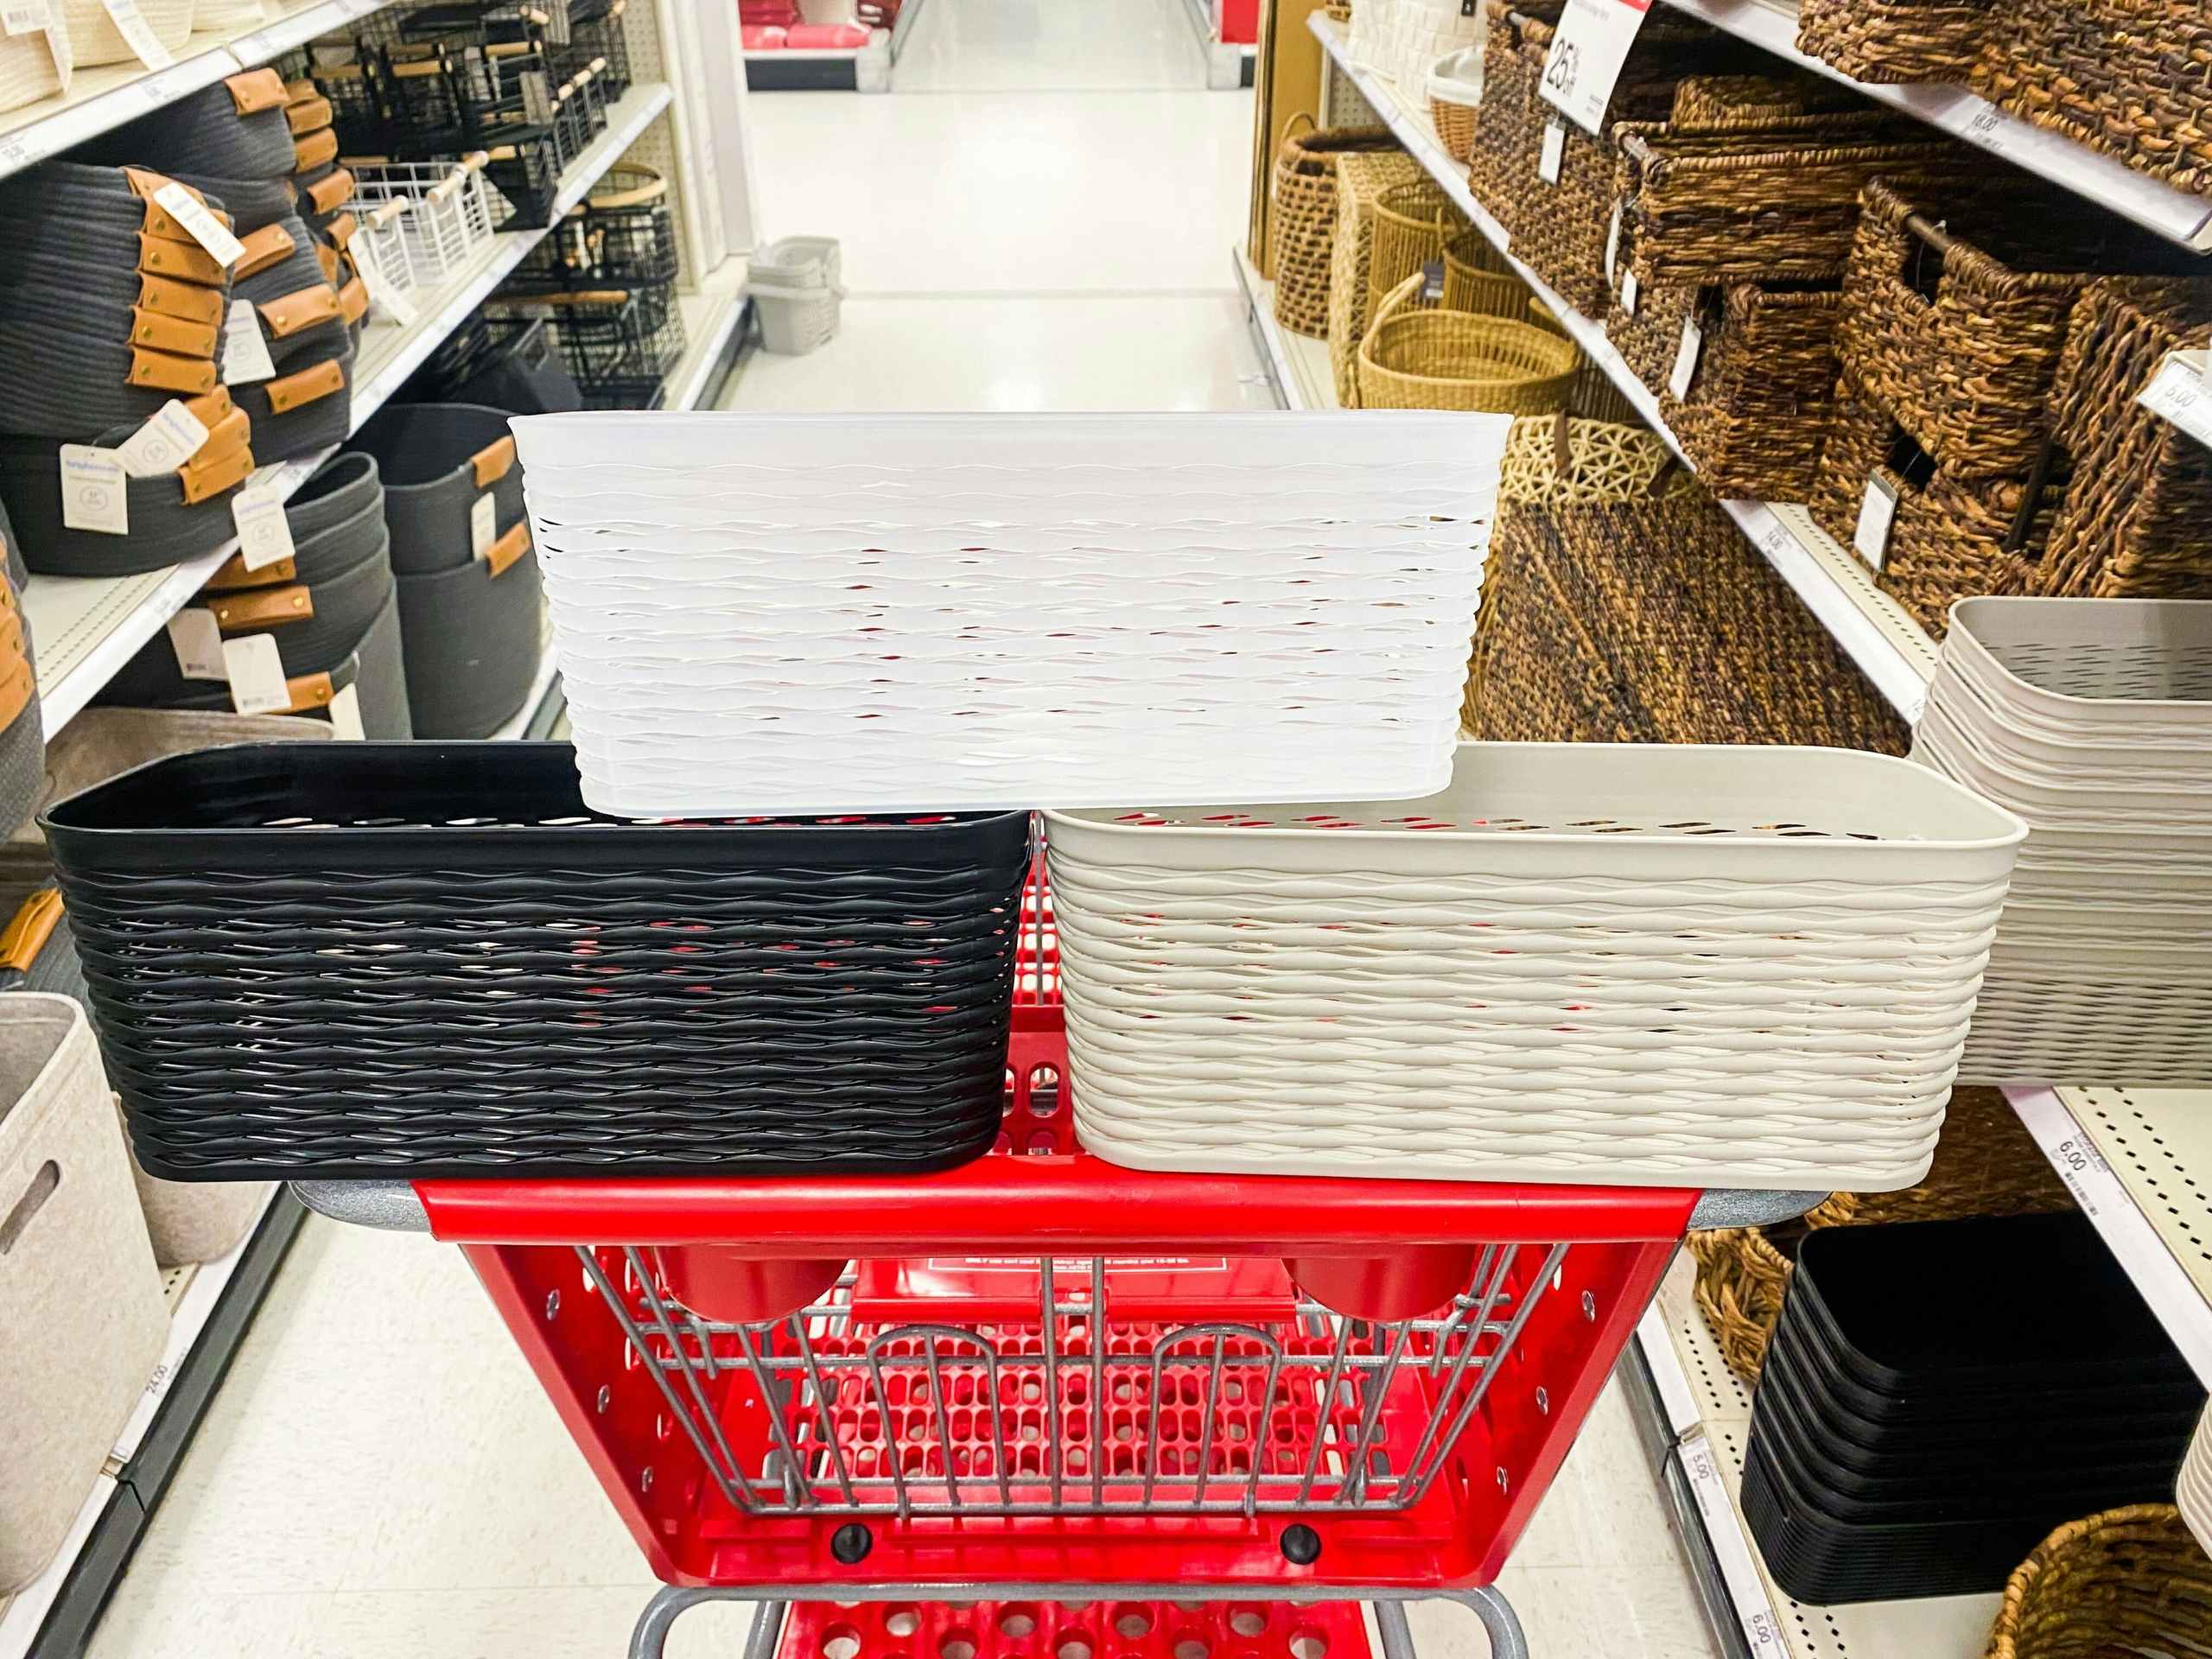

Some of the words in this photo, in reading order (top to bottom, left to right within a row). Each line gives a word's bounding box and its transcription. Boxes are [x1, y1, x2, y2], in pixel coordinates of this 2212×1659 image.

[2164, 386, 2197, 408] 5.00
[2059, 1141, 2087, 1171] 6.00
[1693, 1453, 1710, 1479] 5.00
[1752, 1614, 1771, 1643] 6.00
